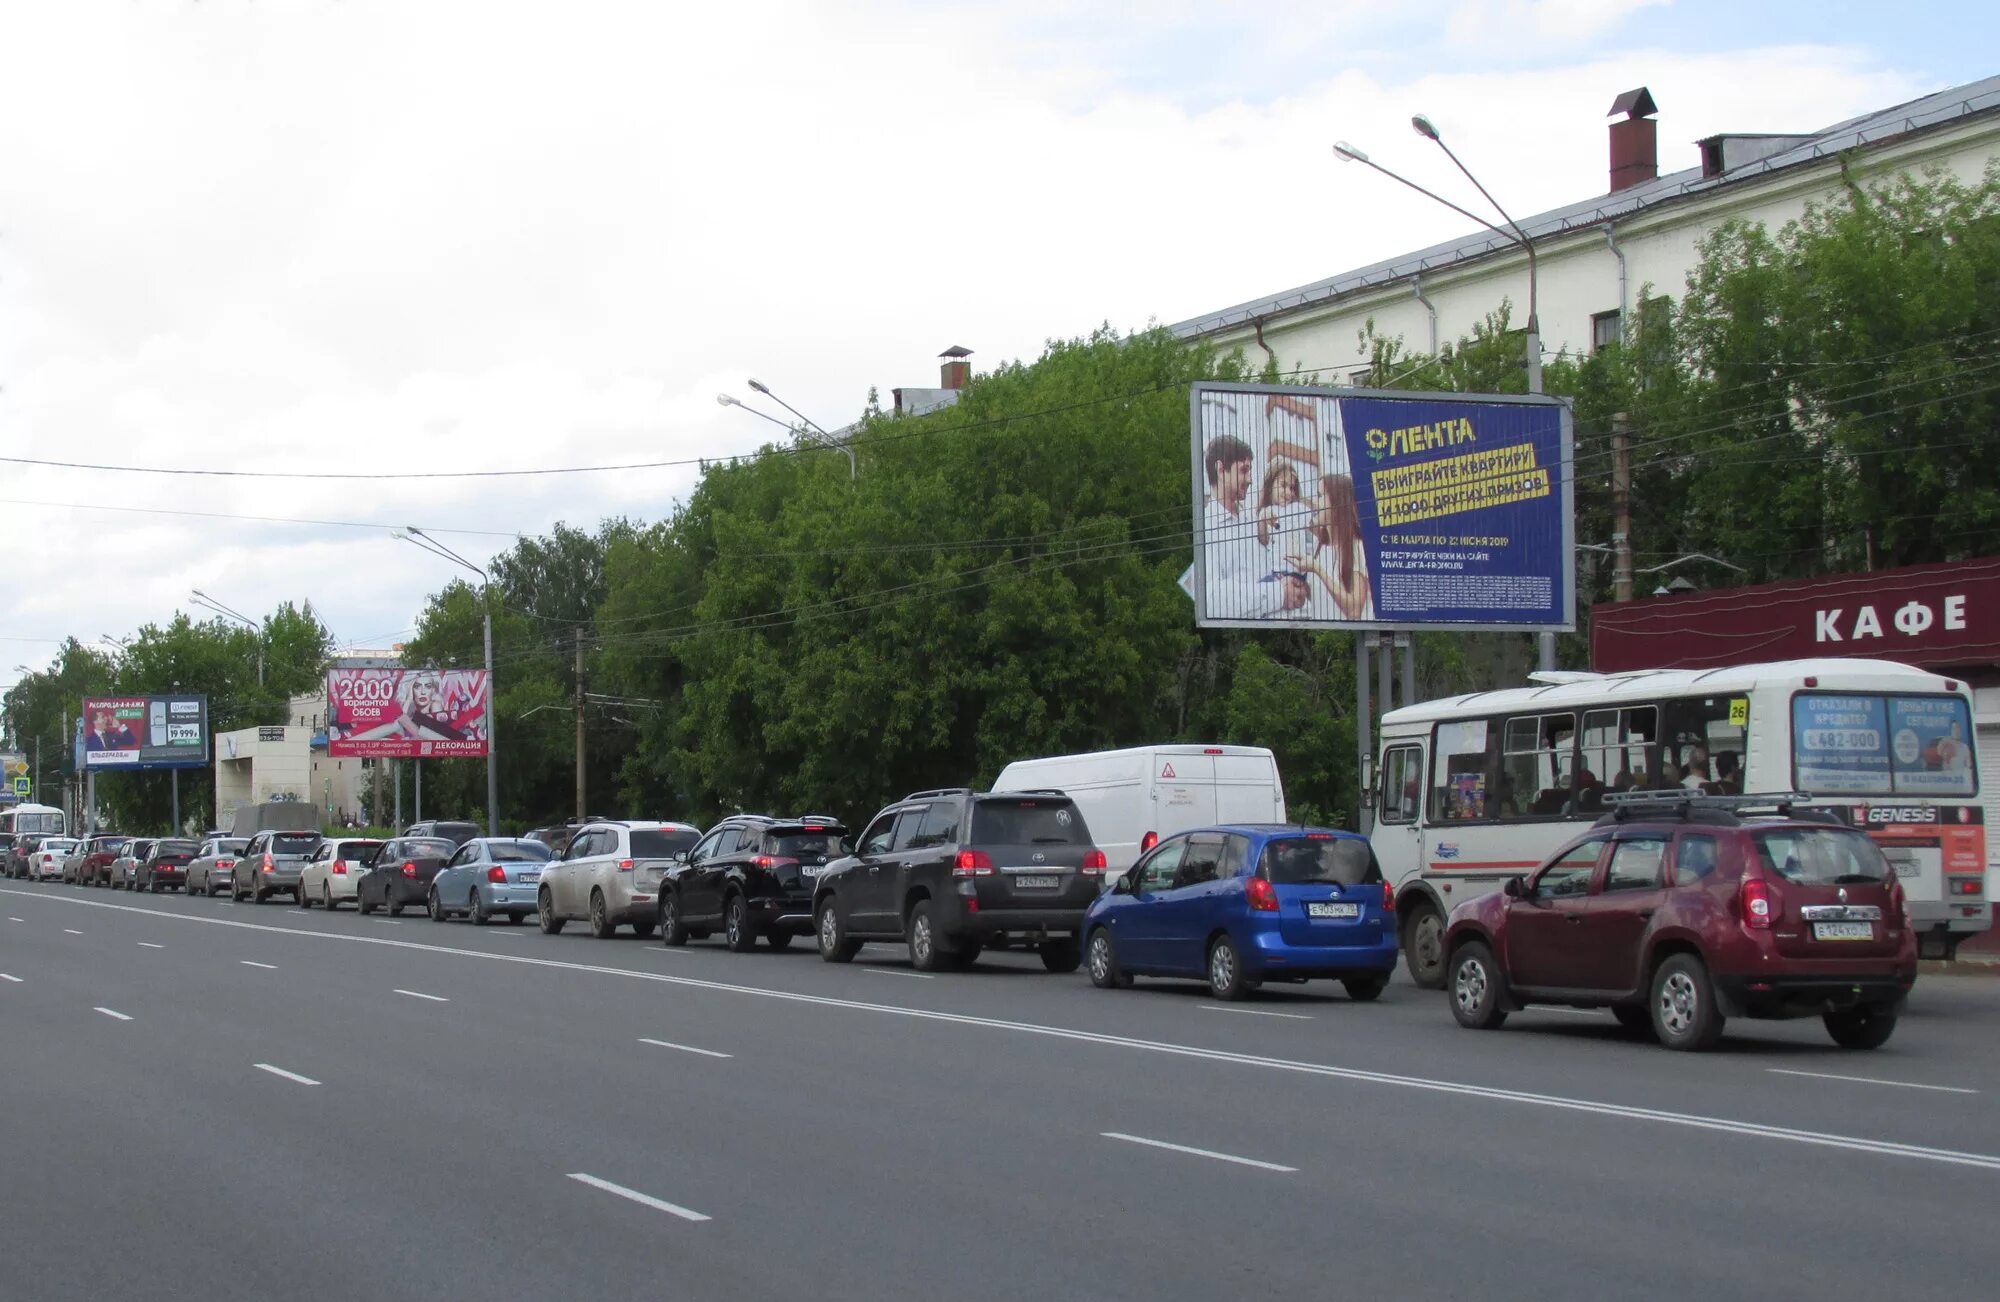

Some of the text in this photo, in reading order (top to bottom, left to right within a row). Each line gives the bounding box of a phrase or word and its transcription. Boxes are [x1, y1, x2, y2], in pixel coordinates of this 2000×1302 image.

[1390, 417, 1476, 456] ЛЕНТА
[1377, 450, 1529, 491] ВЫИГРАЙТЕ КВАРТИРУ
[1382, 476, 1542, 519] И 1000 ДРУГИХ ПРИЗОВ
[1380, 534, 1388, 544] С
[1401, 535, 1432, 545] МАРТА
[1433, 536, 1446, 545] ПО
[1460, 536, 1488, 546] ИЮНЯ
[1489, 537, 1509, 547] 2019
[1381, 550, 1490, 561] РЕГИСТРИРУЙТЕ ЧЕКИ НА САЙТЕ
[1816, 595, 1966, 642] КАФЕ
[340, 678, 393, 699] 2000
[344, 699, 389, 709] вариантов
[1808, 699, 1862, 711] ОТКАЗАЛИ
[1897, 700, 1934, 714] ДЕНЬГИ
[352, 708, 380, 717] ОБОЕВ
[1731, 706, 1744, 718] 26
[1815, 713, 1867, 726] КРЕДИТЕ?
[1818, 732, 1875, 747] 482-000
[1868, 808, 1937, 823] GENESIS
